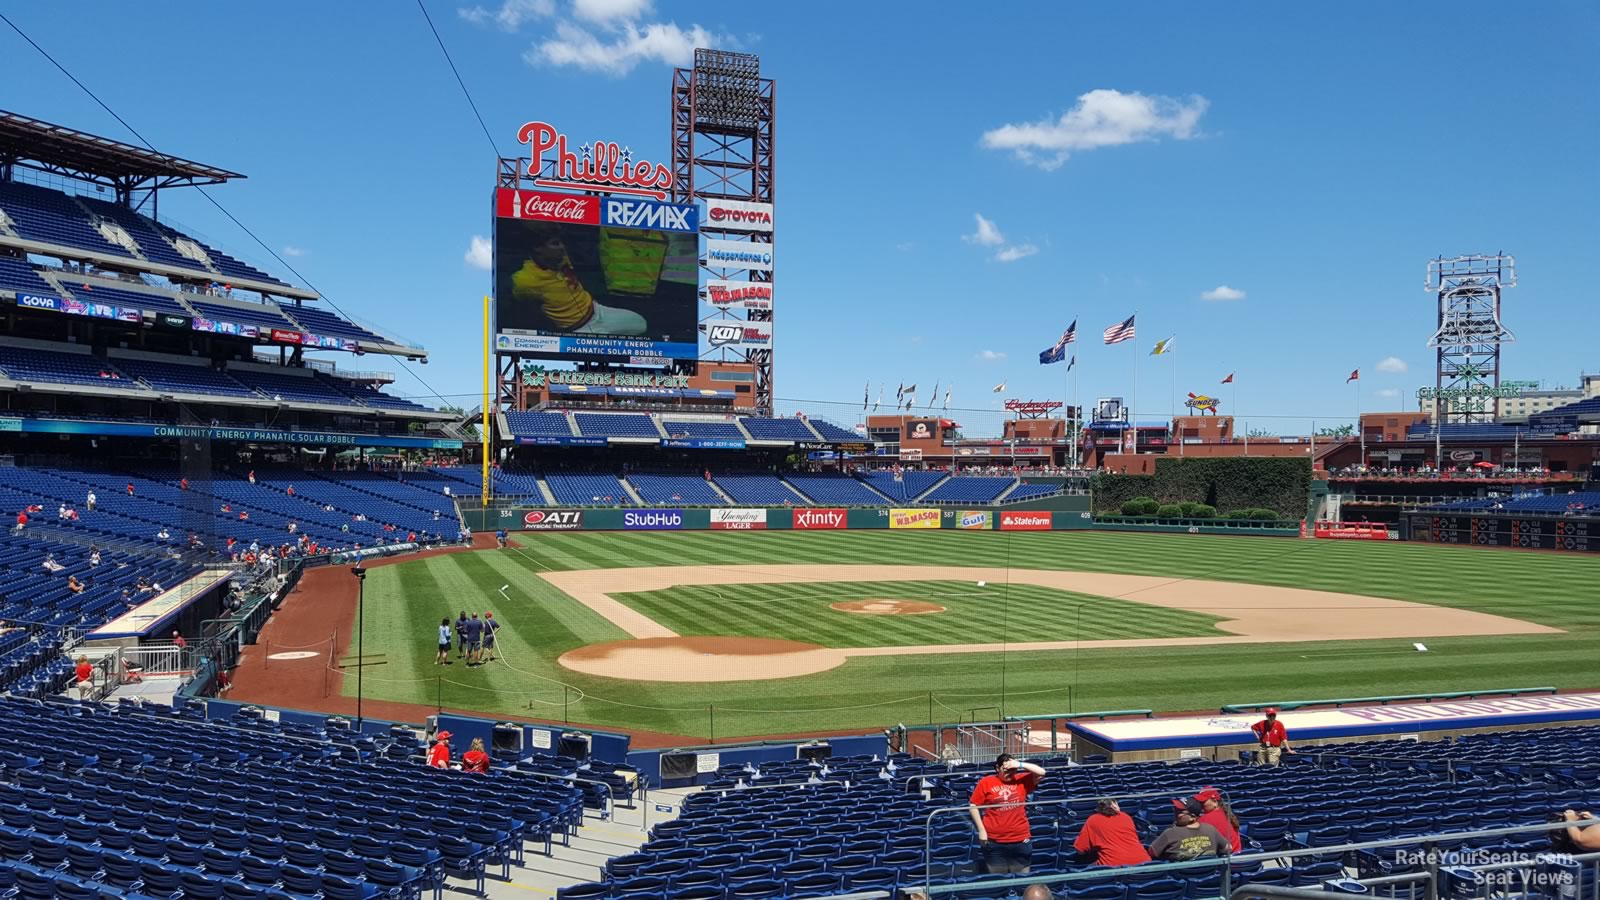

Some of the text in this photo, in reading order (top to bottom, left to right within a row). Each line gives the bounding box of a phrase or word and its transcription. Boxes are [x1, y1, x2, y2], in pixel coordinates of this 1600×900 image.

[517, 121, 672, 189] Phillies
[525, 195, 588, 220] Coca-Cola
[608, 201, 690, 230] RE/MAX
[725, 209, 771, 225] TOYOTA
[708, 249, 762, 263] Independence
[23, 296, 54, 308] GOYA
[514, 337, 558, 345] COMMUNITY
[576, 338, 622, 346] COMMUNITY
[566, 346, 604, 354] PHANATIC
[548, 368, 689, 388] Citizens Bank Park
[1419, 385, 1520, 399] Citizens Bank
[1187, 399, 1218, 407] SUNOCO
[1452, 400, 1485, 411] Park
[153, 427, 356, 444] COMMUNITY ENERGY PHANATIC SOLAR BOBBLE
[806, 442, 832, 450] NovaCare
[500, 510, 512, 518] 334
[543, 512, 580, 523] ATI
[624, 512, 682, 526] StubHub
[716, 510, 760, 522] Yuengling
[797, 511, 844, 527] xfinity
[962, 514, 985, 526] Gulf
